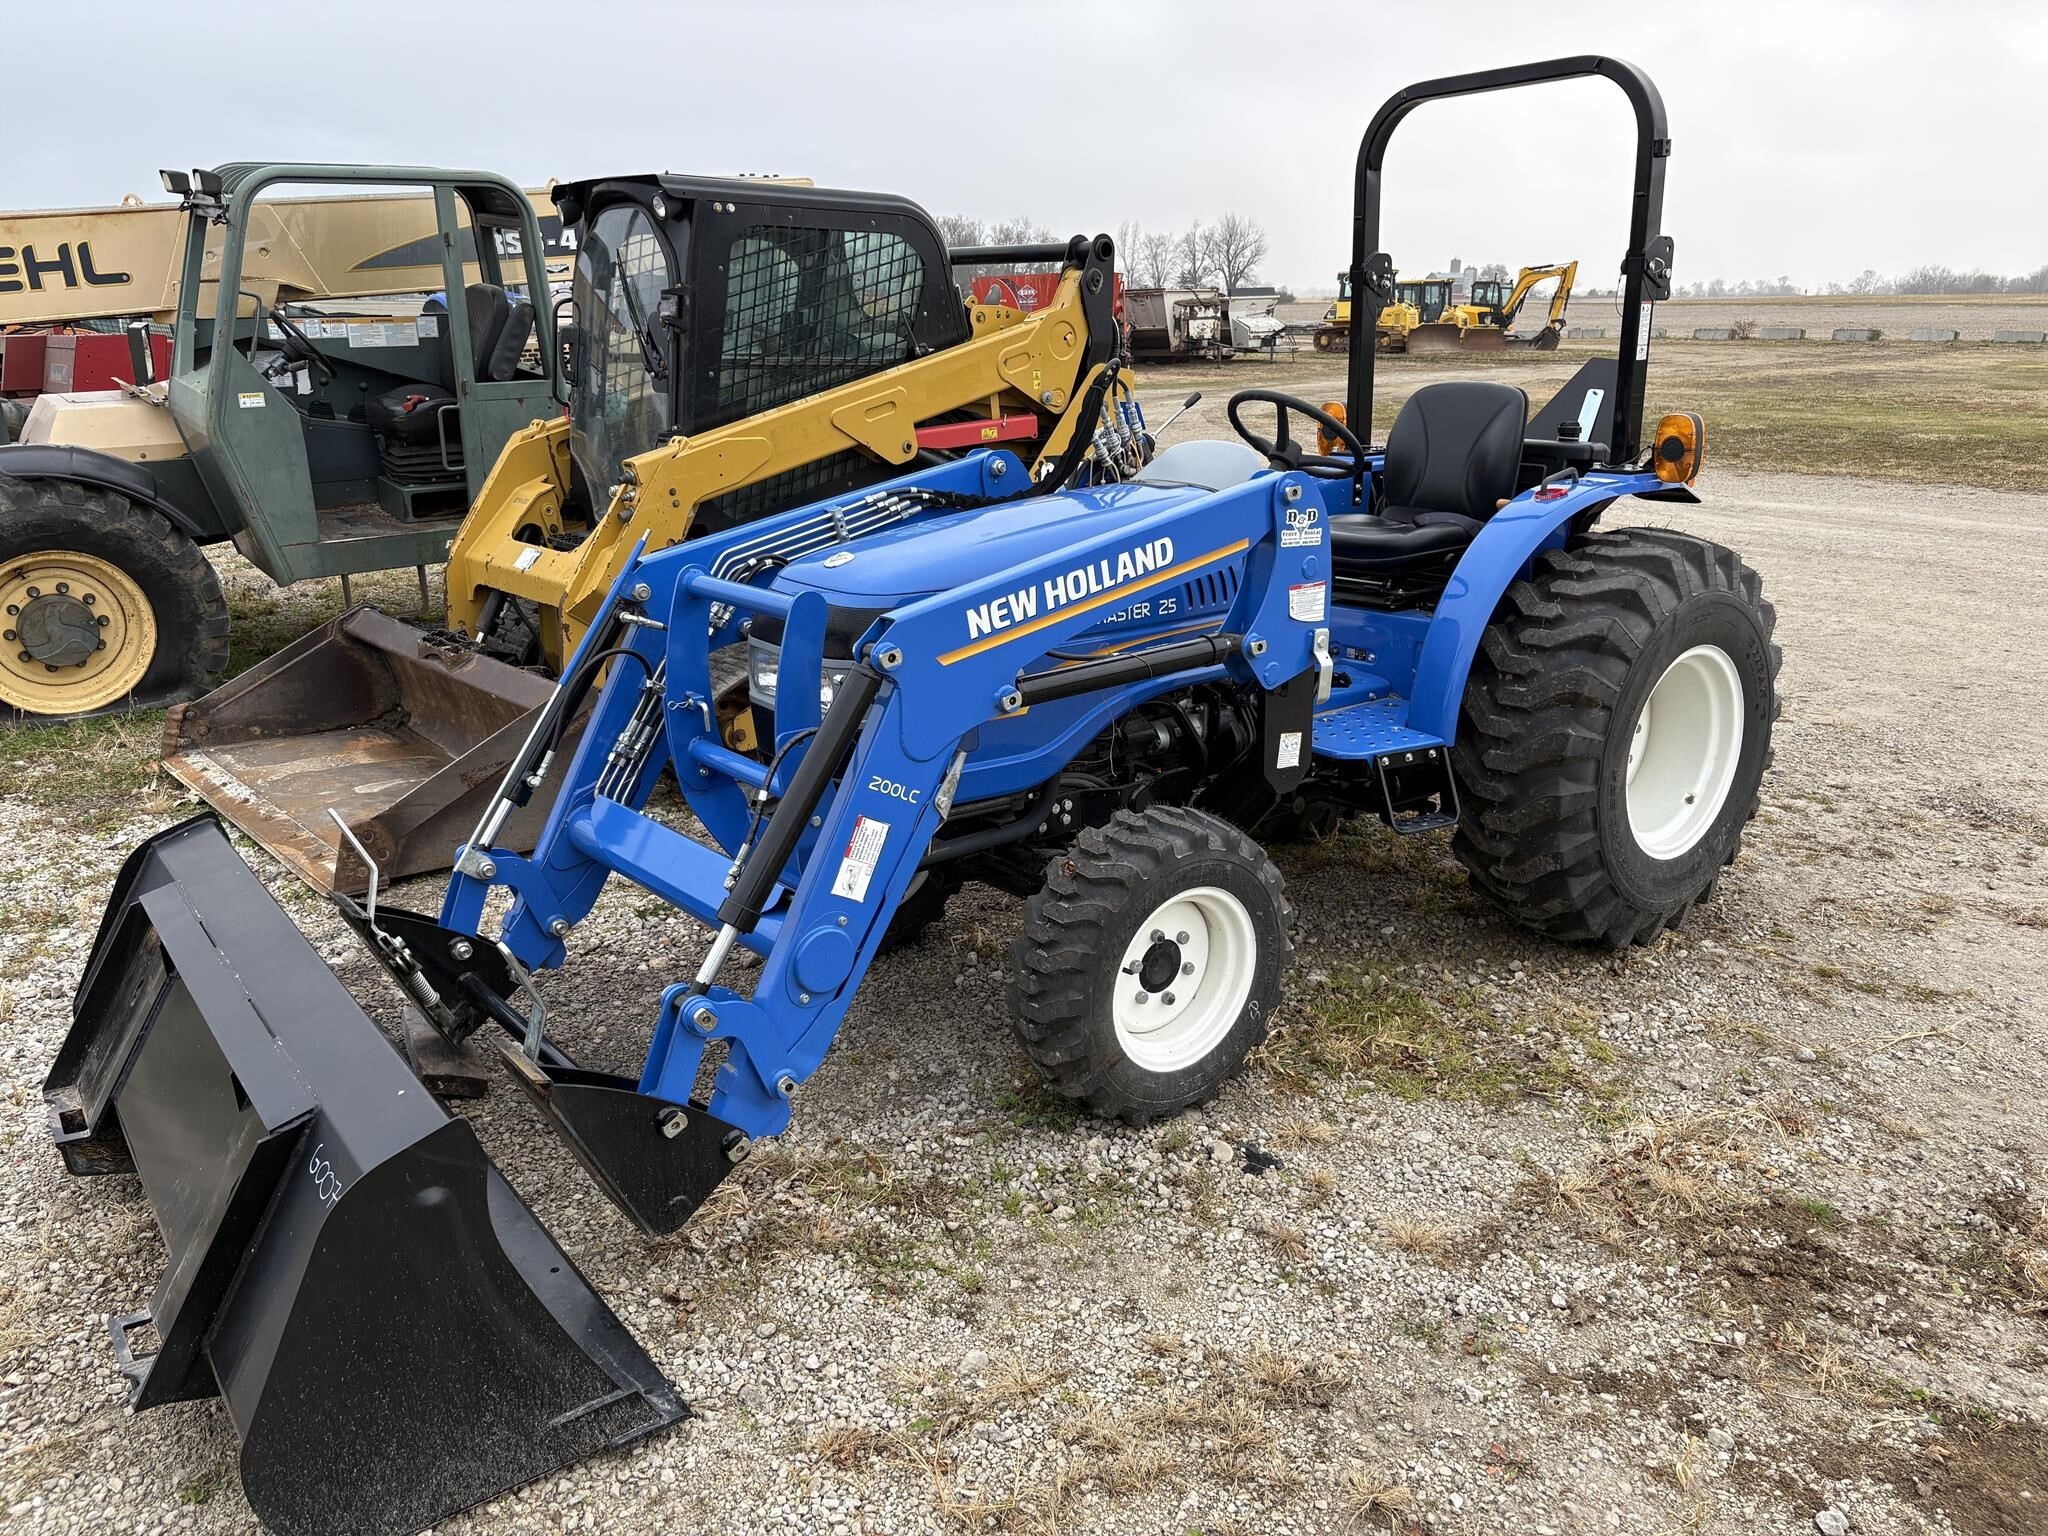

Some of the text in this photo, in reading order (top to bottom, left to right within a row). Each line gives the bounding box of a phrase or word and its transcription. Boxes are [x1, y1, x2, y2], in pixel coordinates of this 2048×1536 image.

[966, 536, 1174, 640] NEW HOLLAND
[1159, 597, 1177, 616] 25
[868, 775, 920, 804] 200LC
[309, 1143, 342, 1208] 6007
